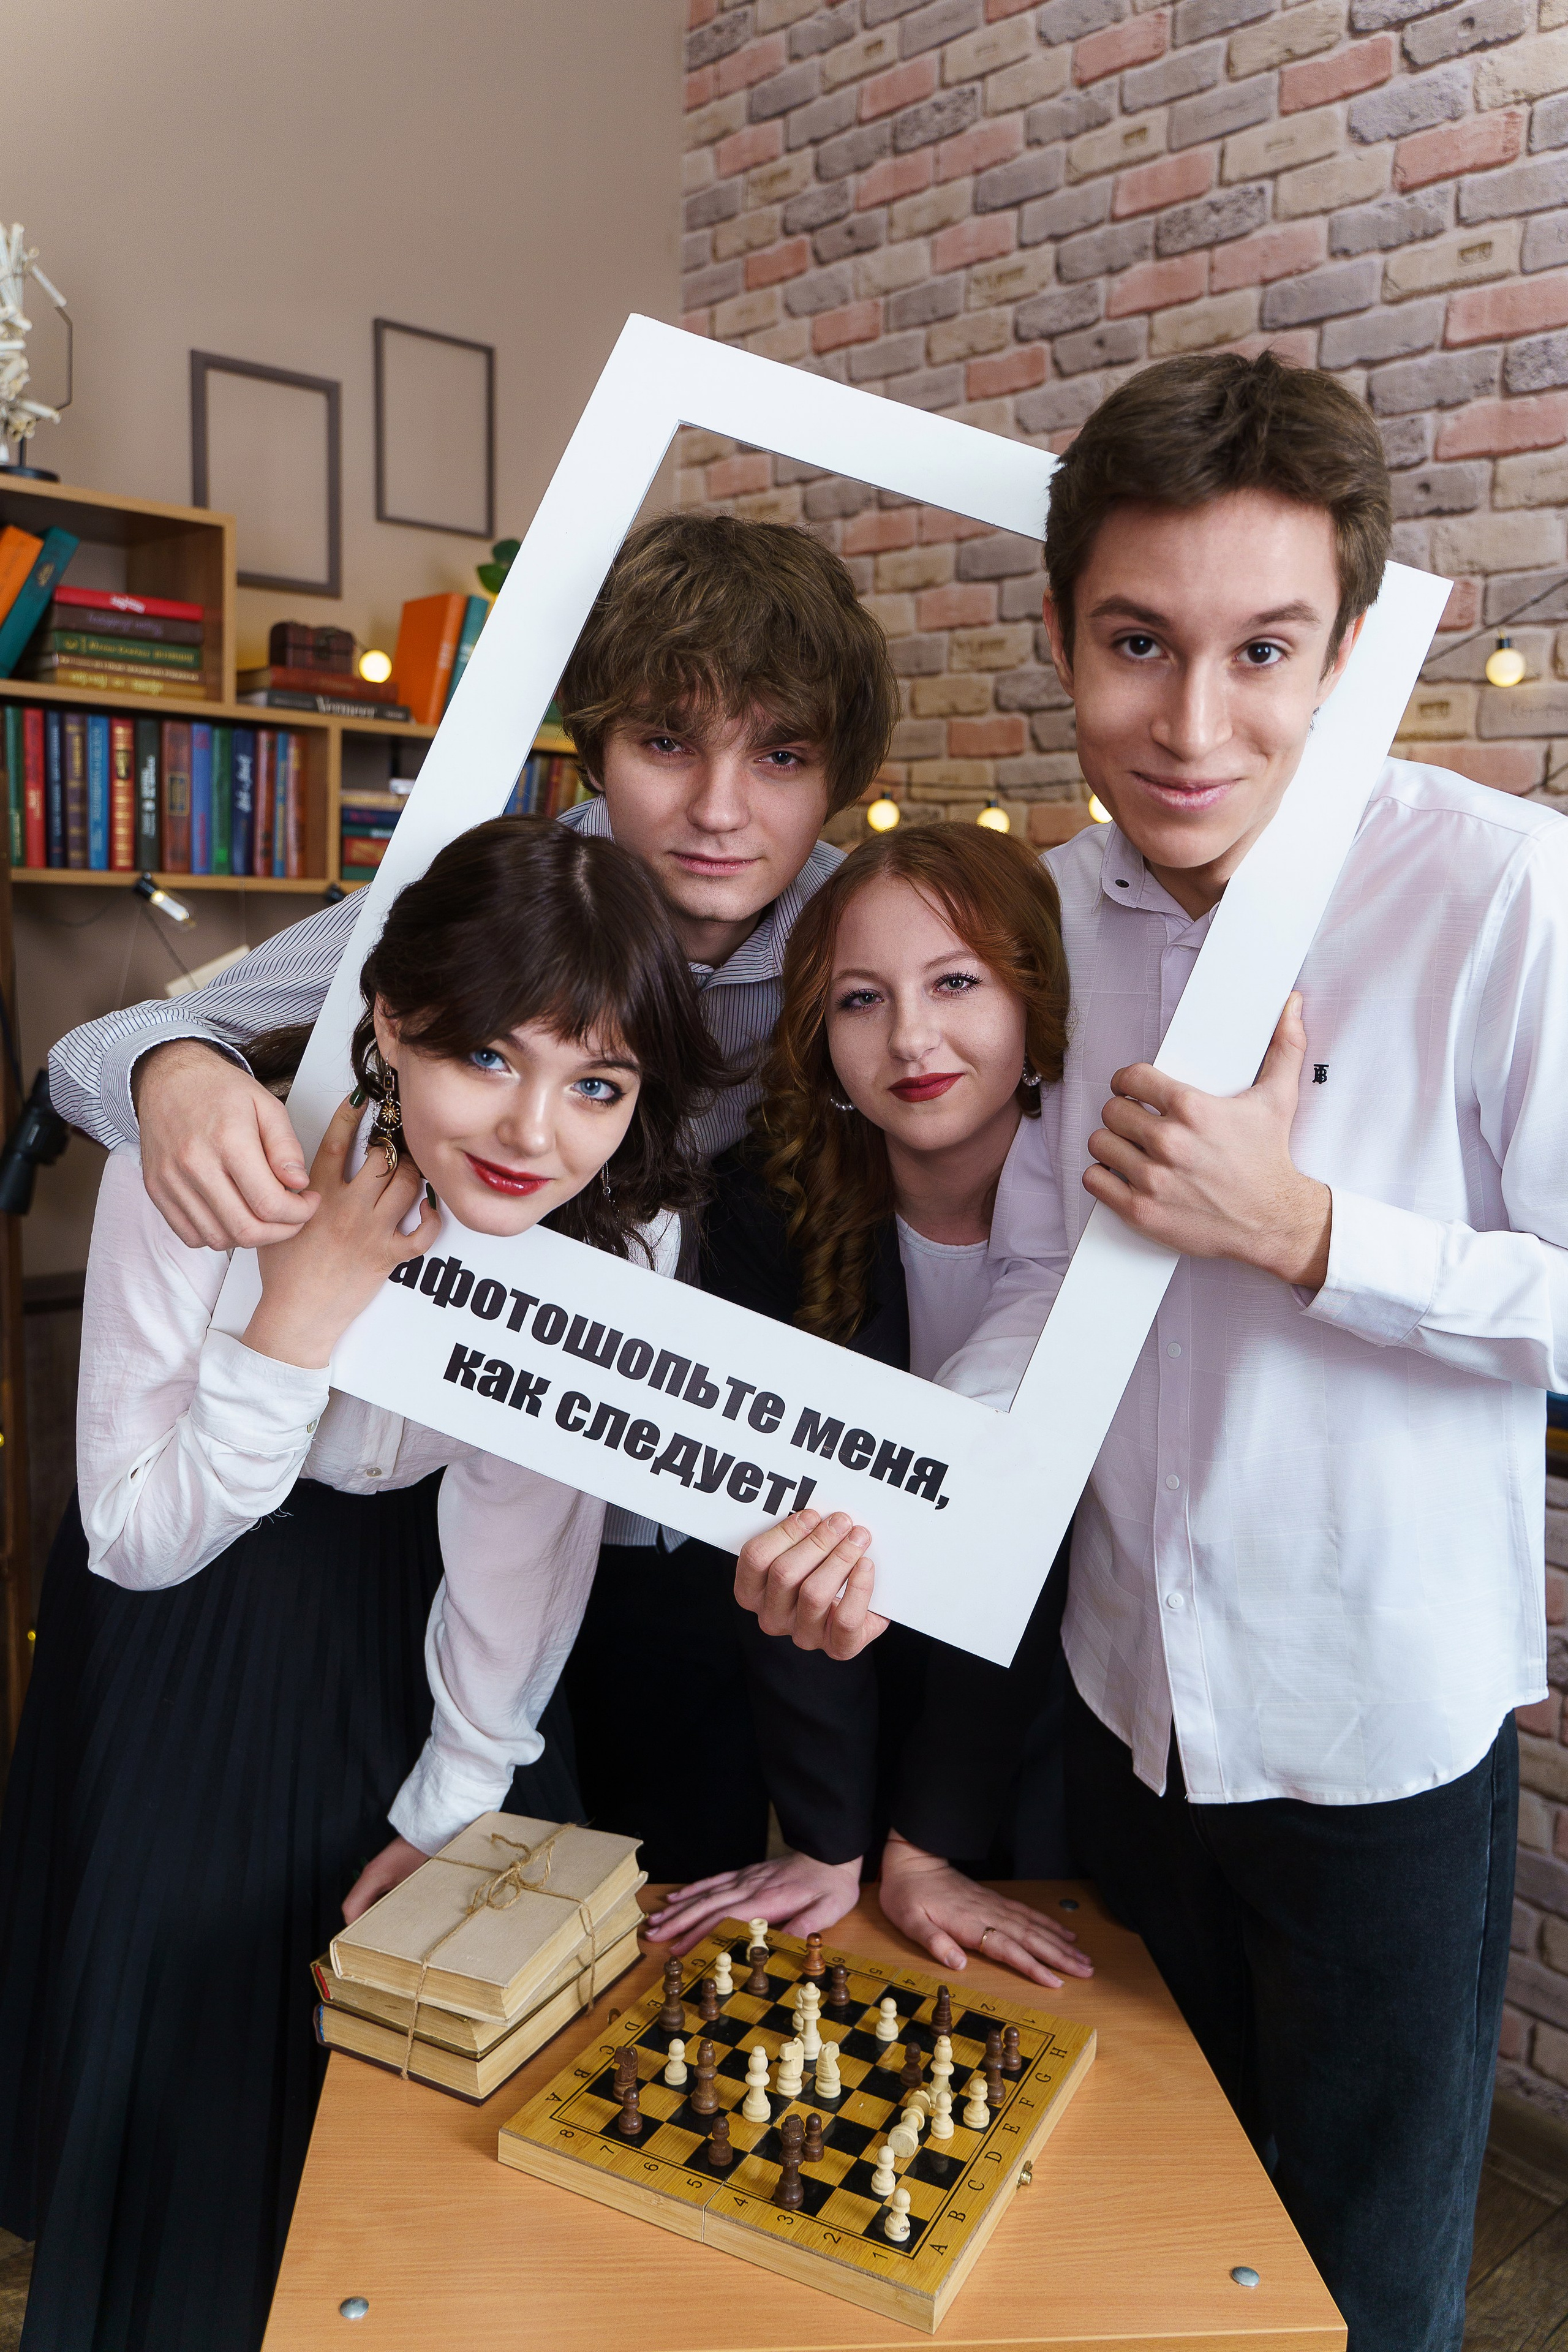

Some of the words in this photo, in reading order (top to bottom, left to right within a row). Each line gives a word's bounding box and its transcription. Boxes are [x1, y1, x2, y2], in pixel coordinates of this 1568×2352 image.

[388, 1254, 786, 1434] афотошопьте
[790, 1406, 950, 1510] меня,
[443, 1342, 552, 1418] как
[555, 1390, 818, 1517] следует!
[712, 1937, 728, 1948] H
[647, 1999, 663, 2009] E
[981, 2002, 996, 2011] 2
[625, 2021, 641, 2032] D
[599, 2045, 615, 2056] C
[1049, 2046, 1068, 2059] H
[573, 2068, 590, 2079] B
[1035, 2072, 1052, 2082] G
[545, 2092, 562, 2102] A
[1019, 2097, 1035, 2109] F
[1002, 2123, 1021, 2135] E
[984, 2150, 1002, 2163] D
[559, 2129, 575, 2138] 8
[600, 2145, 614, 2154] 7
[643, 2162, 659, 2171] 6
[687, 2178, 703, 2188] 5
[733, 2196, 748, 2207] 4
[777, 2214, 794, 2225] 3
[823, 2232, 842, 2244] 2
[967, 2179, 985, 2191] C
[947, 2210, 966, 2223] B
[929, 2243, 948, 2256] A
